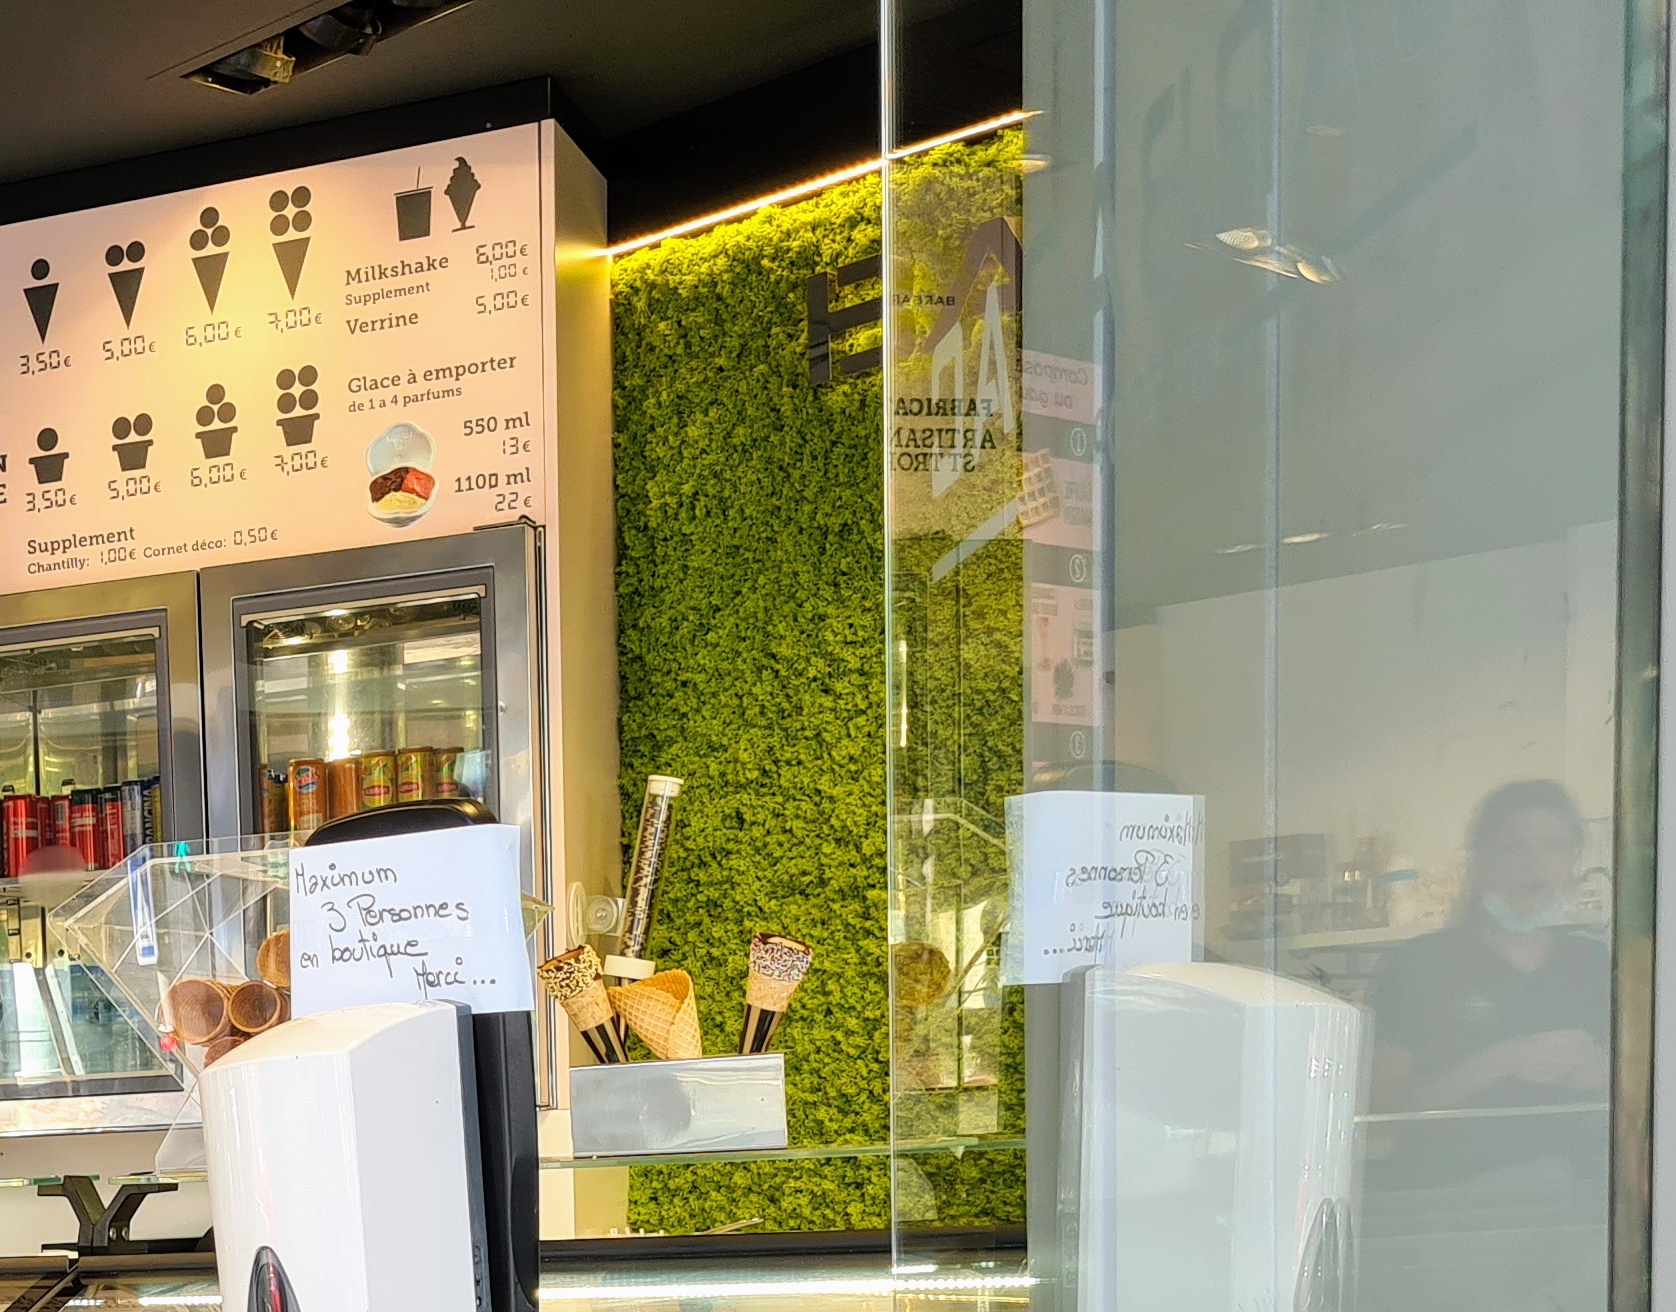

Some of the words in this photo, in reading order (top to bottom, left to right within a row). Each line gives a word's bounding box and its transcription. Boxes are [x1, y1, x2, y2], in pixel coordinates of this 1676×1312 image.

[344, 255, 449, 286] Milkshake
[344, 281, 431, 307] Supplement
[346, 311, 419, 335] Verrine
[348, 373, 401, 394] Glace
[407, 366, 418, 385] à
[423, 355, 517, 384] emporter
[348, 400, 364, 413] de
[368, 398, 376, 410] 1
[378, 399, 386, 409] a
[390, 393, 398, 407] 4
[402, 385, 462, 408] parfums
[463, 416, 498, 437] 550
[504, 411, 530, 431] ml
[454, 473, 499, 494] 1100
[505, 467, 531, 486] ml
[27, 526, 136, 558] Supplement
[27, 556, 91, 575] Chantilly:
[143, 542, 188, 559] Cornet
[191, 536, 227, 552] déco:
[295, 863, 397, 897] Maximum
[321, 901, 346, 933] 3
[348, 894, 470, 927] Personnes
[300, 951, 319, 969] en
[331, 932, 428, 978] boutique
